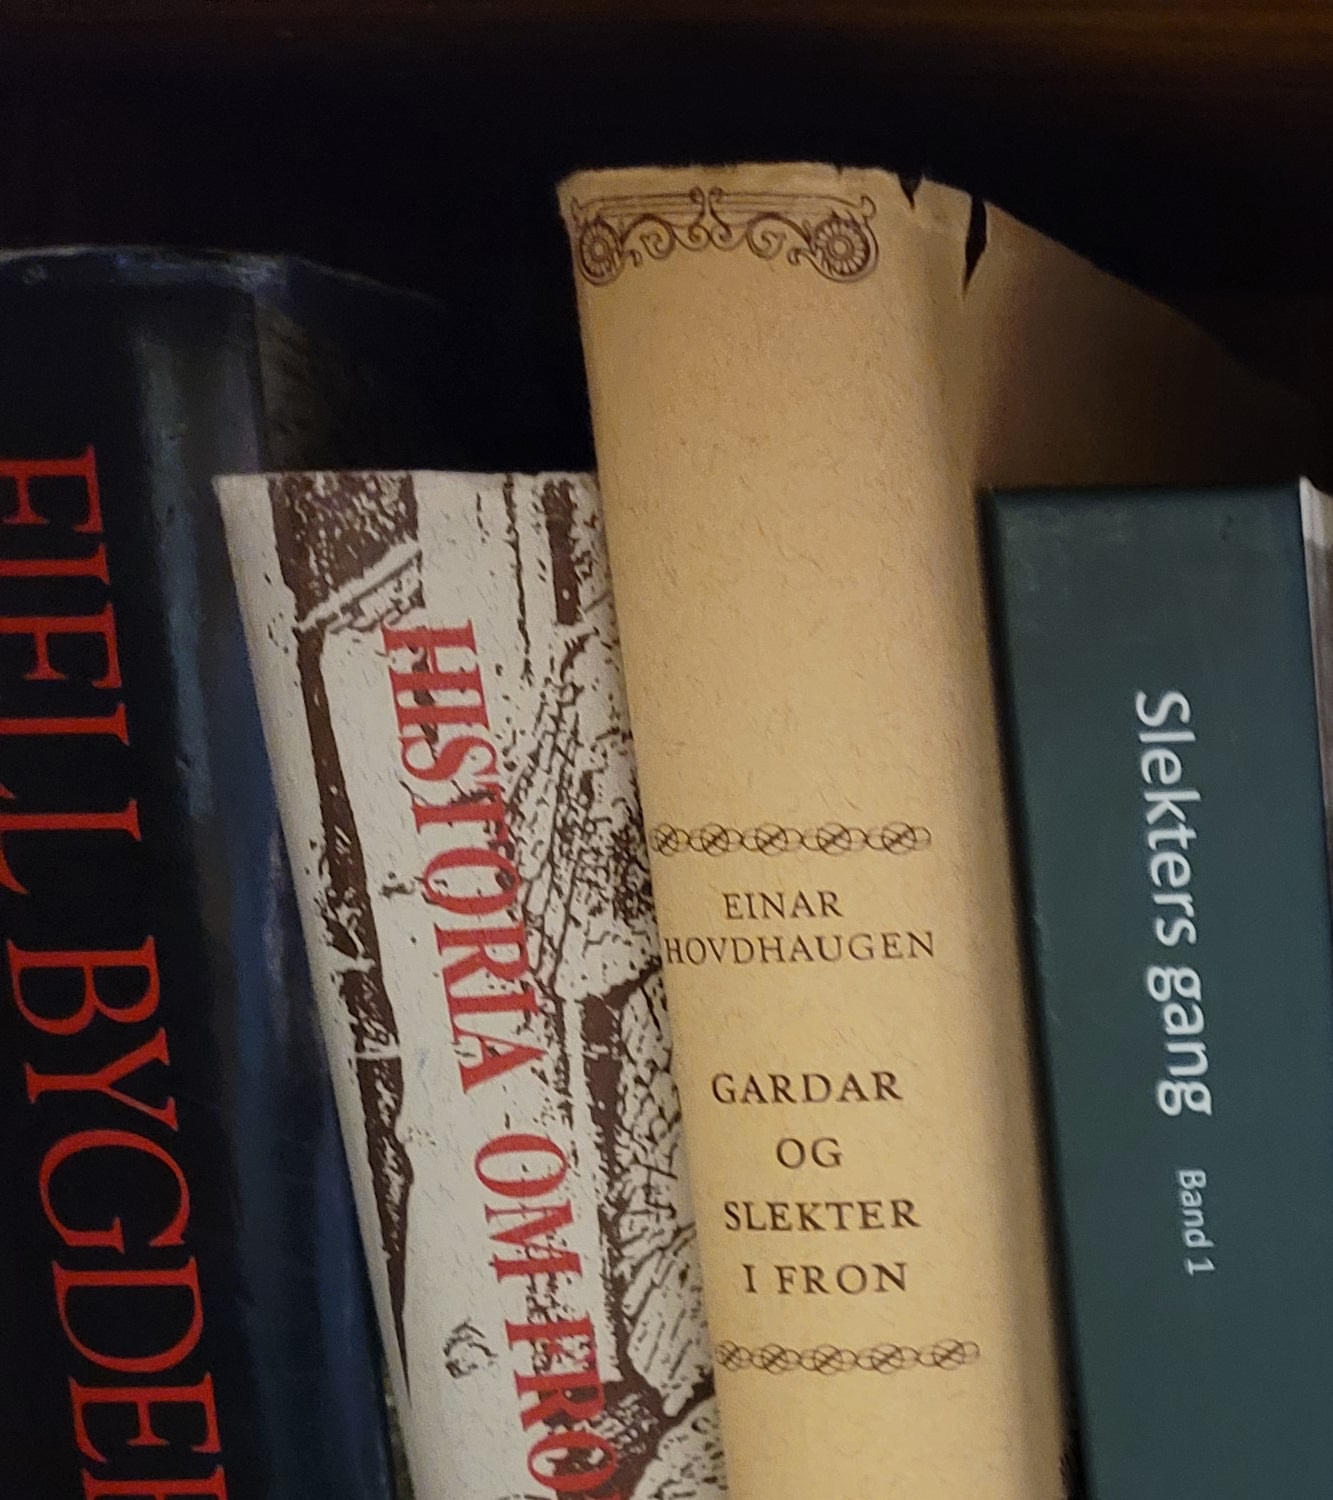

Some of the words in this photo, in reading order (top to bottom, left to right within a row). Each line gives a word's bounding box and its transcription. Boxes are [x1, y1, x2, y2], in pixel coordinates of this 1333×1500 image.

[1135, 689, 1201, 949] Slekters
[723, 889, 844, 920] EINAR
[381, 618, 549, 1095] HISTORIA
[475, 1133, 583, 1284] OM
[665, 931, 936, 966] HOVDHAUGEN
[1147, 964, 1212, 1117] gang
[711, 1070, 903, 1105] GARDAR
[776, 1136, 843, 1170] OG
[724, 1198, 921, 1232] SLEKTER
[1176, 1168, 1215, 1250] Band
[743, 1262, 757, 1293] I
[776, 1262, 909, 1296] FRON
[1186, 1256, 1216, 1276] 1
